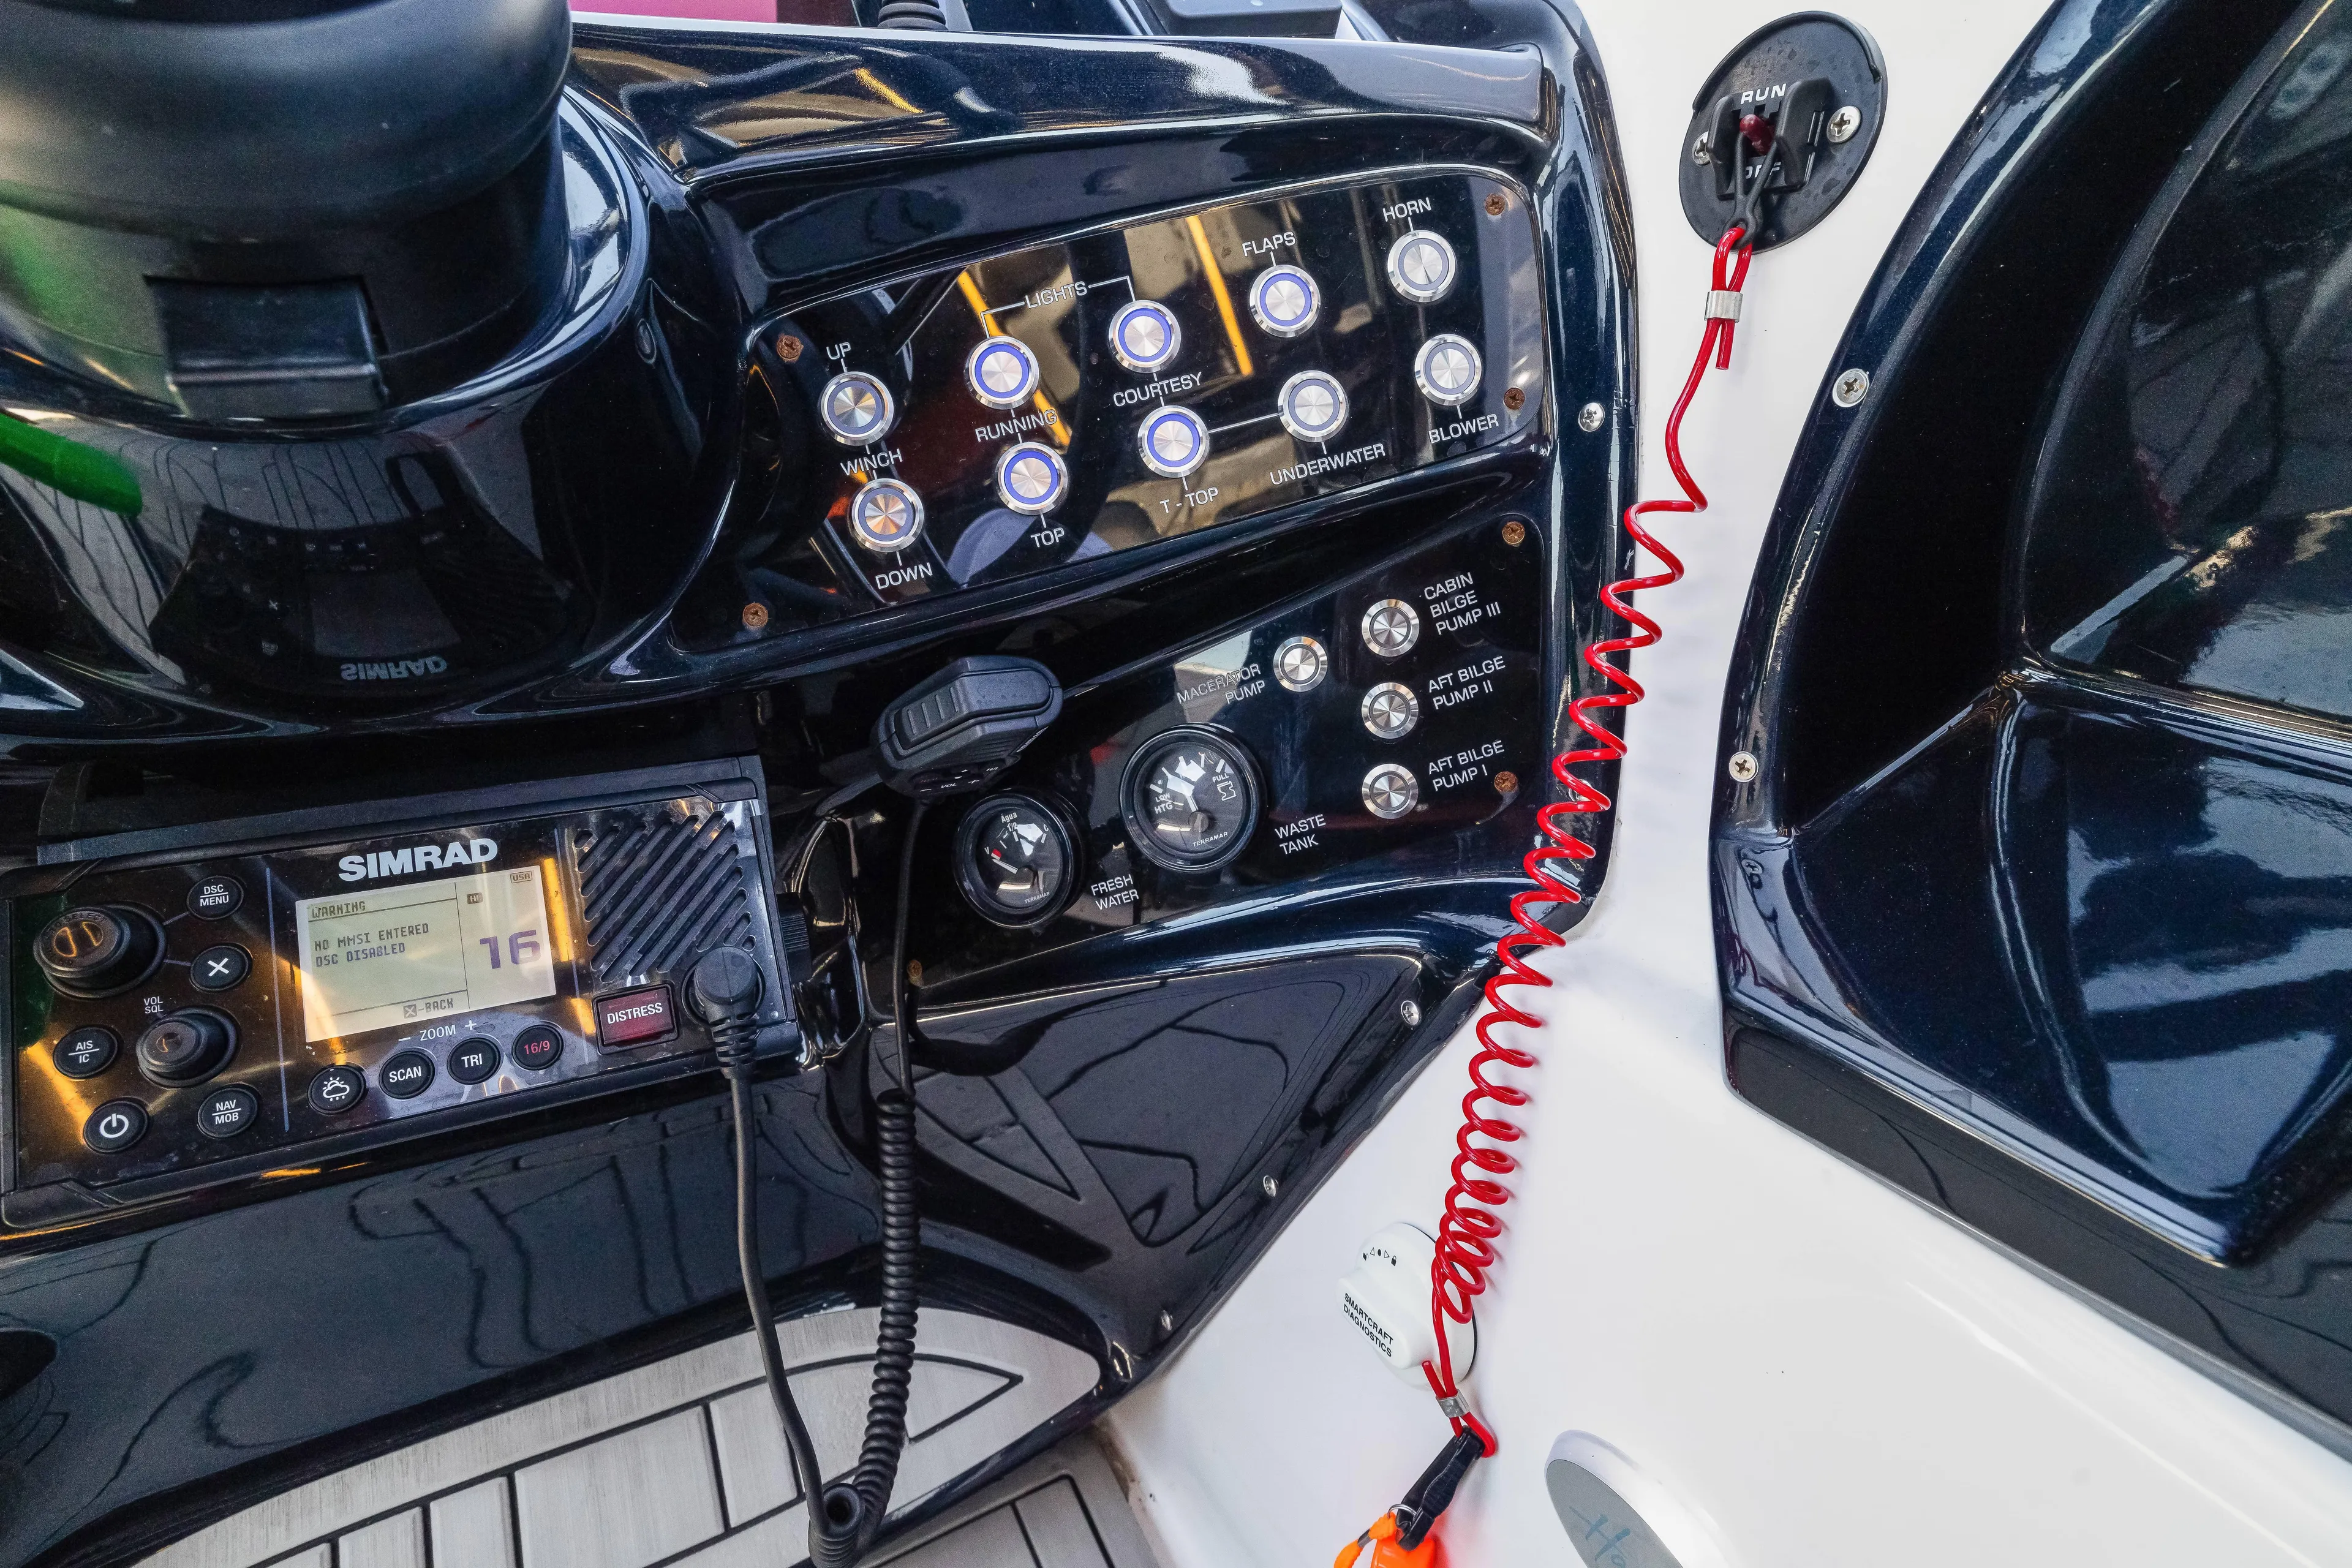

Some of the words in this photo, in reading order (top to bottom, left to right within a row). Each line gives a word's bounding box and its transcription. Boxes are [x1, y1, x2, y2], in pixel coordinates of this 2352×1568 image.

[1740, 83, 1787, 105] RUN
[1382, 197, 1432, 222] HORN
[1242, 231, 1297, 257] FLAPS
[1025, 281, 1088, 309] LIGHTS
[827, 342, 852, 360] UP
[1113, 372, 1203, 407] COURTESY
[974, 409, 1058, 442] RUNNING
[1428, 414, 1499, 443] BLOWER
[840, 449, 903, 477] WINCH
[1269, 443, 1386, 486] UNDERWATER
[1159, 499, 1171, 513] T
[1185, 487, 1219, 508] TOP
[1030, 527, 1065, 548] TOP
[875, 562, 933, 589] DOWN
[1424, 572, 1474, 600] CABIN
[1430, 590, 1478, 618] BILGE
[1436, 608, 1482, 635] PUMP
[1486, 601, 1501, 617] III
[1176, 663, 1261, 704] MACERATOR
[1428, 673, 1453, 693] AFT
[1457, 655, 1506, 682] BILGE
[1225, 680, 1265, 704] PUMP
[1433, 684, 1479, 710] PUMP
[1483, 679, 1493, 693] II
[1428, 755, 1453, 775] AFT
[1457, 740, 1505, 765] BILGE
[1212, 773, 1230, 783] FULL
[1432, 766, 1478, 792] PUMP
[1482, 764, 1488, 776] I
[1155, 793, 1170, 802] LOW
[1155, 802, 1174, 814] HTG
[1001, 812, 1017, 823] Água
[1275, 813, 1326, 839] WASTE
[1193, 831, 1228, 847] TERRAMAR
[1279, 834, 1319, 855] TANK
[338, 838, 498, 881] SIMRAD
[204, 884, 224, 894] DSC
[512, 873, 530, 882] USA
[1090, 873, 1134, 897] FRESH
[200, 895, 229, 907] MENU
[1024, 891, 1050, 903] TERRAMAR
[1095, 889, 1139, 911] WATER
[312, 900, 366, 919] WARNING
[314, 938, 329, 952] NO
[337, 932, 371, 948] MMSI
[379, 922, 429, 941] ENTERED
[316, 953, 339, 968] DSC
[347, 943, 405, 962] DISABLED
[480, 929, 541, 970] 16
[143, 996, 164, 1006] VOL
[145, 1005, 164, 1014] SQL
[606, 1003, 663, 1024] DISTRESS
[420, 1024, 456, 1041] ZOOM
[75, 1040, 93, 1050] AIS
[523, 1040, 550, 1055] 16/9
[79, 1054, 89, 1063] IC
[461, 1054, 483, 1068] TRI
[389, 1066, 422, 1082] SCAN
[216, 1099, 236, 1111] NAV
[215, 1112, 239, 1125] MOB
[1344, 1292, 1393, 1345] SMARTCRAFT
[1344, 1303, 1392, 1357] DIAGNOSTICS
